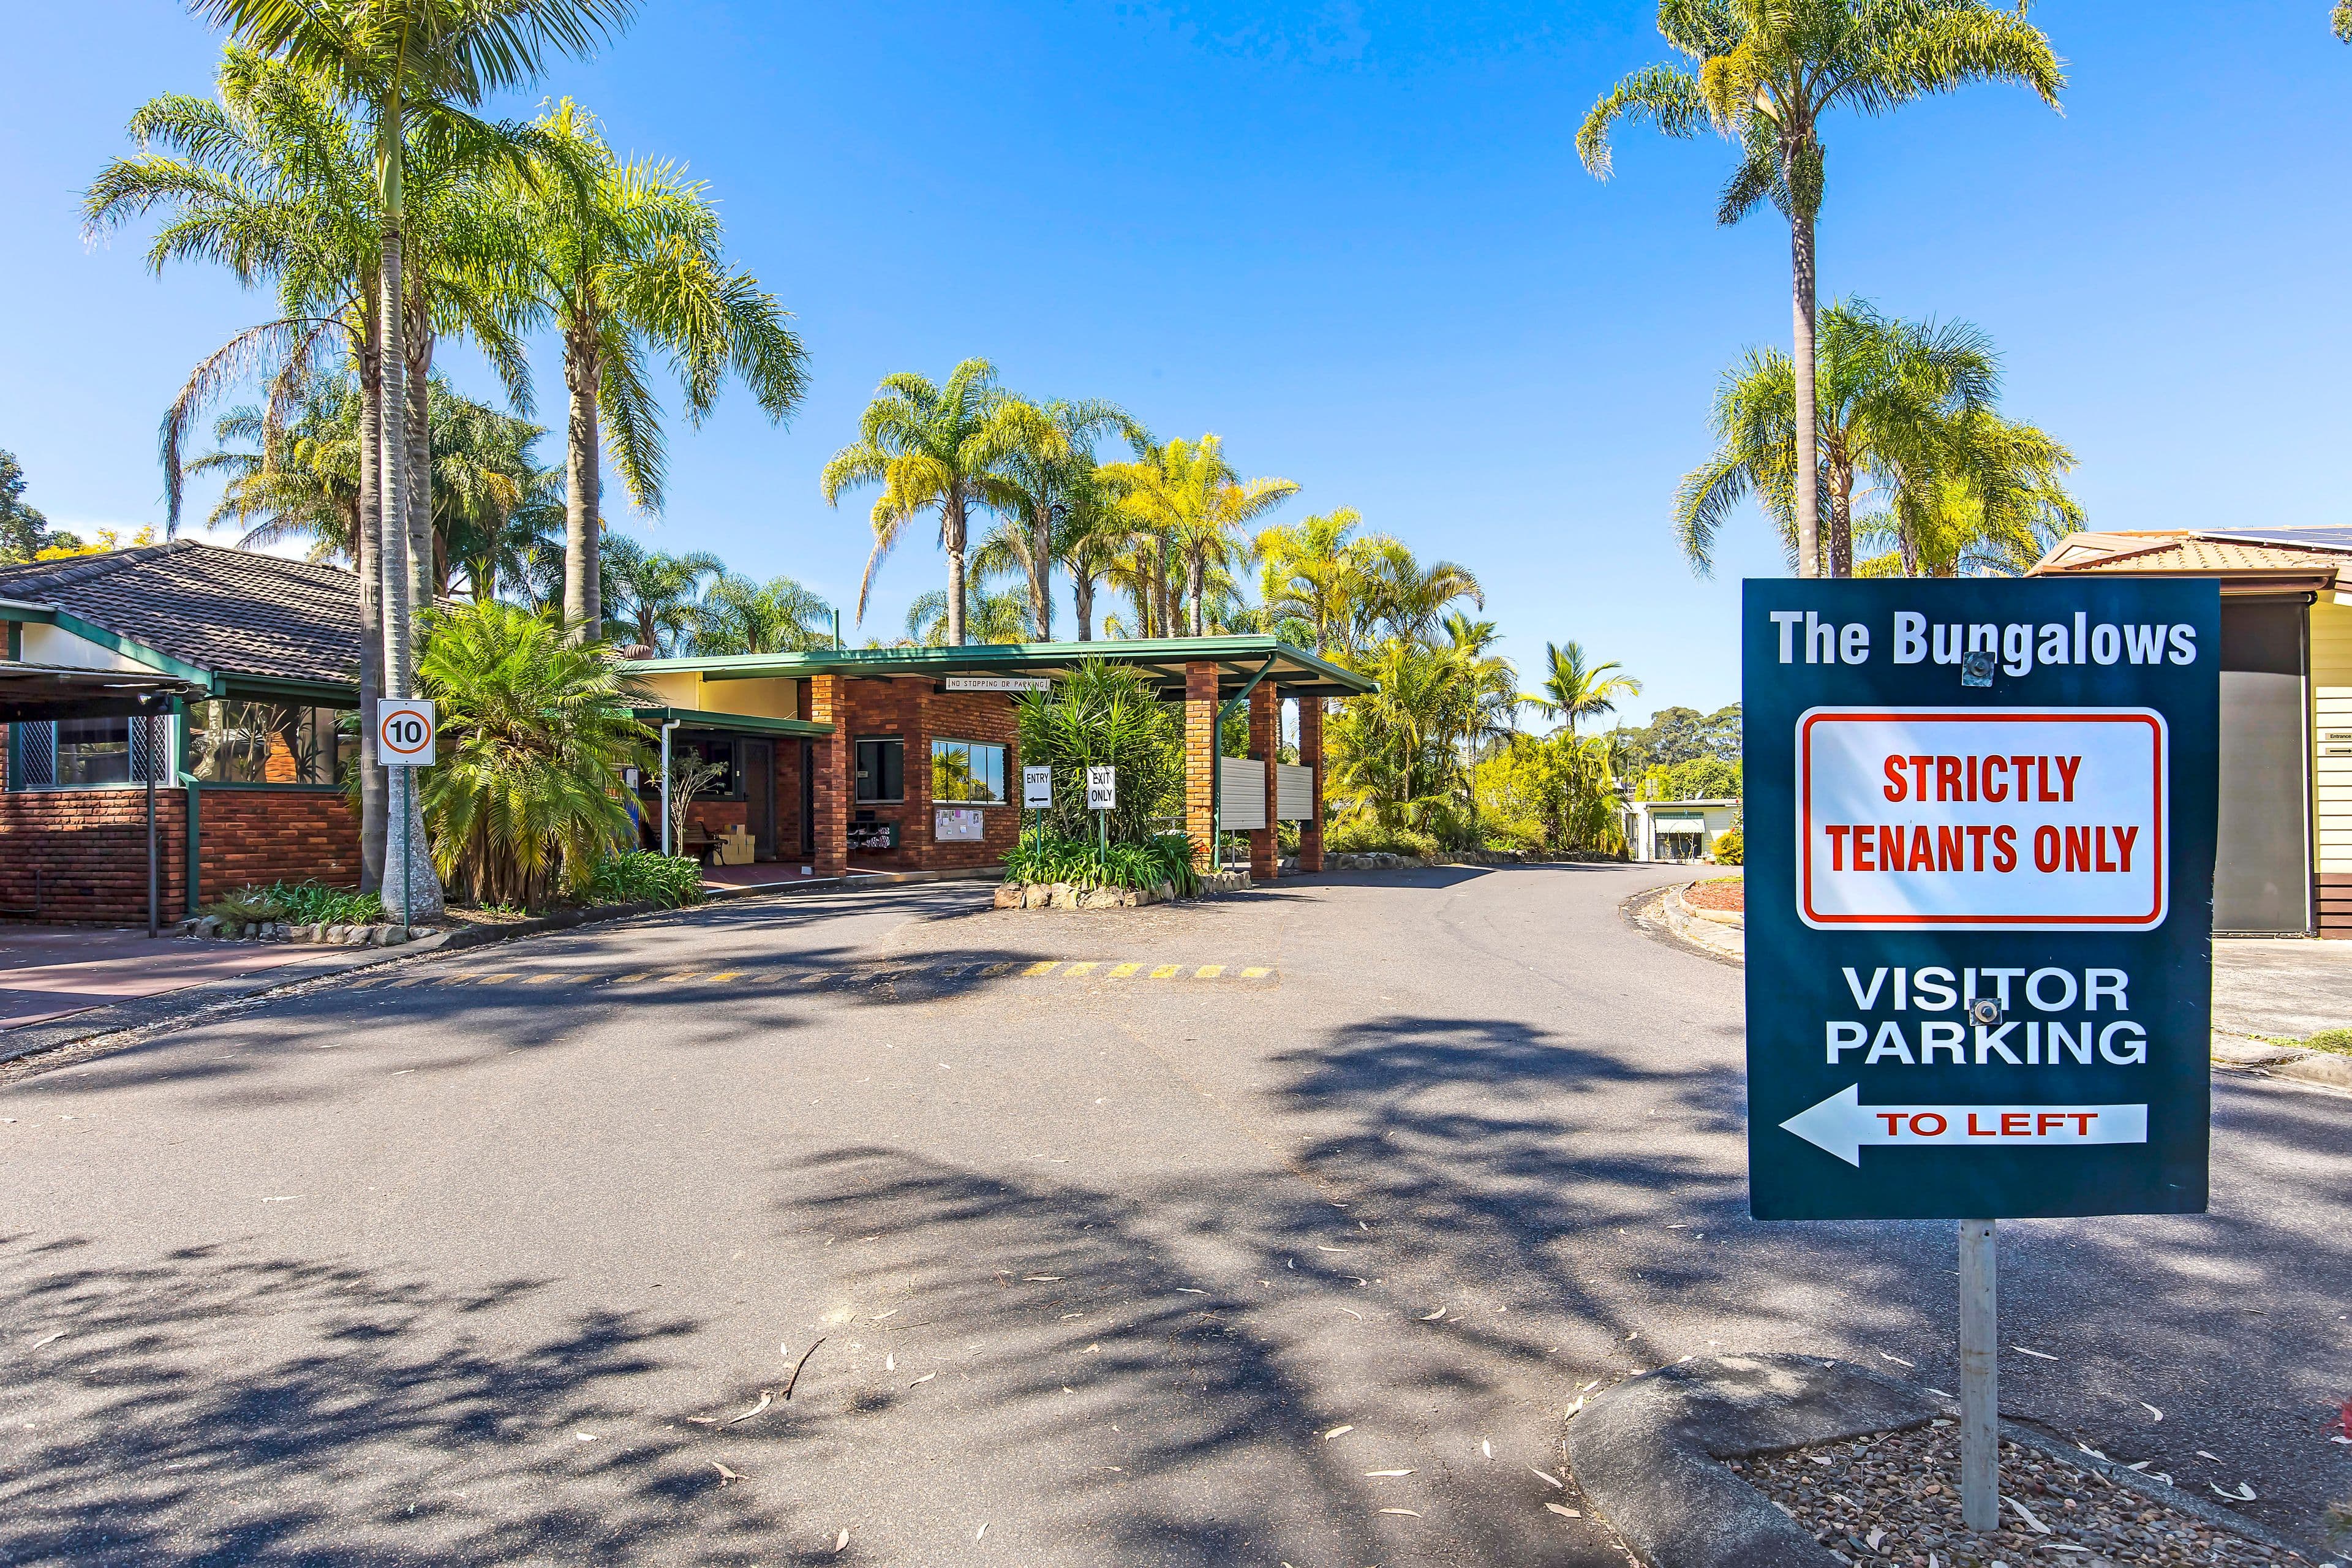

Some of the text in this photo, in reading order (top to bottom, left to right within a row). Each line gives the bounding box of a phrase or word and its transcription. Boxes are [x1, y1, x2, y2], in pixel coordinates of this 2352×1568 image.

[1770, 611, 2196, 677] The Bungalows
[390, 720, 421, 743] 10
[1027, 773, 1049, 783] ENTRY
[1093, 772, 1110, 784] EXIT
[1883, 755, 2081, 802] STRICTLY
[1091, 790, 1112, 802] ONLY
[1826, 825, 2138, 873] TENANTS ONLY
[1842, 967, 2129, 1011] VISITOR
[1826, 1021, 2146, 1065] PARKING
[1877, 1113, 2098, 1136] TO LEFT
